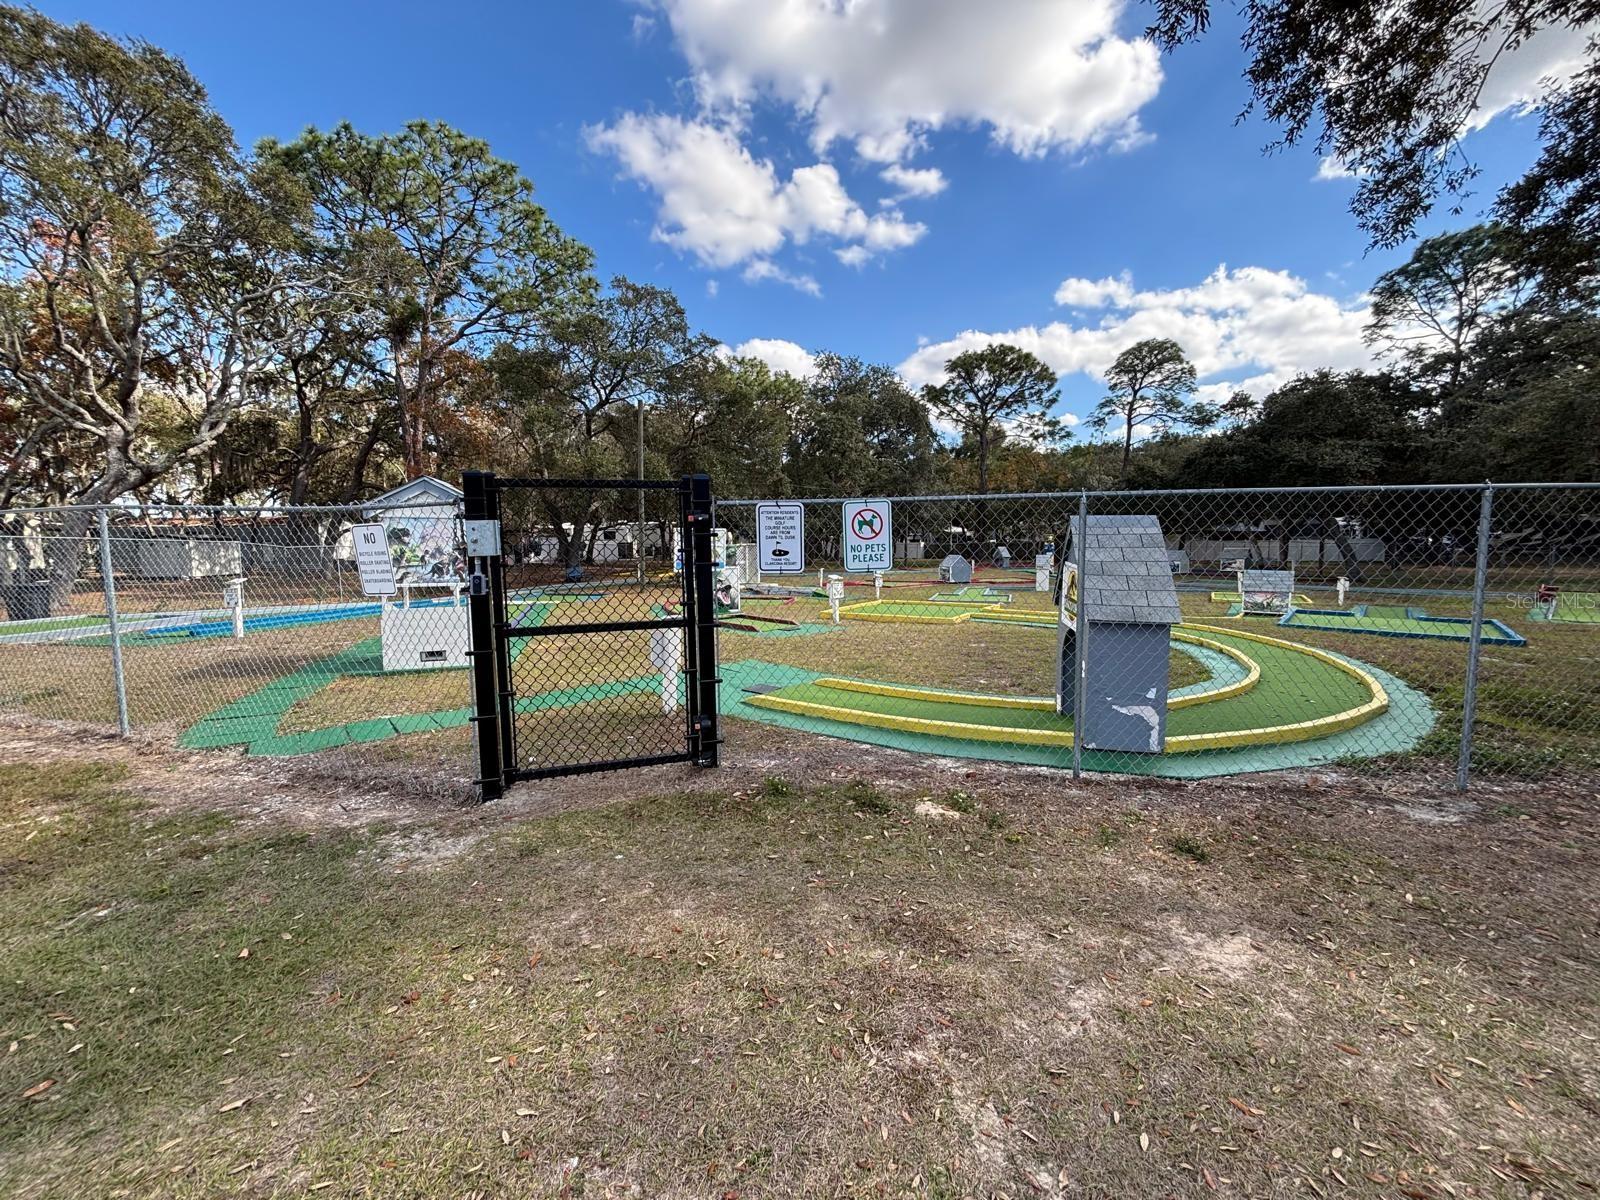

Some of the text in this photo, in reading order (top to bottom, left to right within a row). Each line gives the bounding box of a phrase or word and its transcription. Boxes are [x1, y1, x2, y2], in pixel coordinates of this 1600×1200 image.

[363, 532, 376, 544] NO
[850, 544, 886, 553] NO PETS
[853, 554, 884, 562] PLEASE
